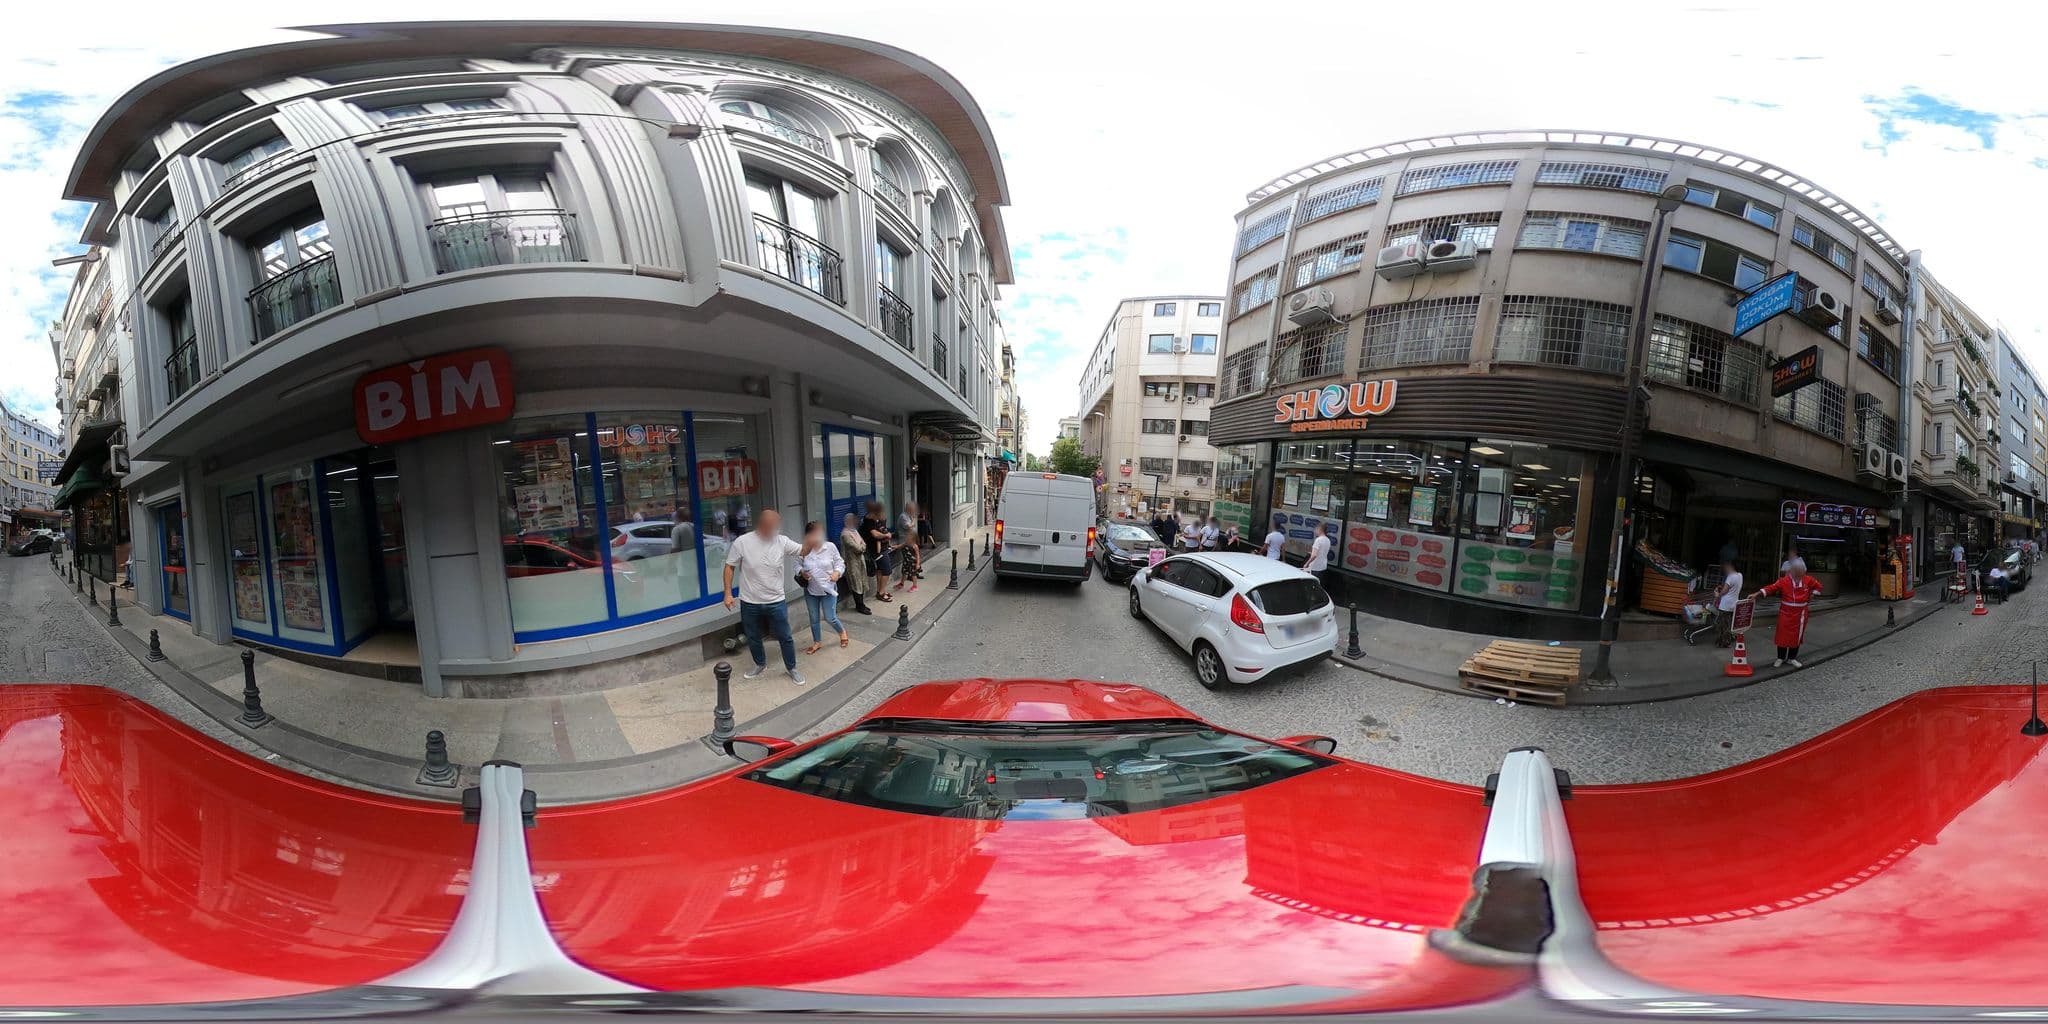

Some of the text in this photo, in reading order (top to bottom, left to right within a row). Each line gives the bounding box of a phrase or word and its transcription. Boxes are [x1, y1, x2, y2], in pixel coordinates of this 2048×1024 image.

[1774, 354, 1816, 382] SHOW
[365, 360, 501, 431] BİM
[1274, 380, 1398, 423] SHOW
